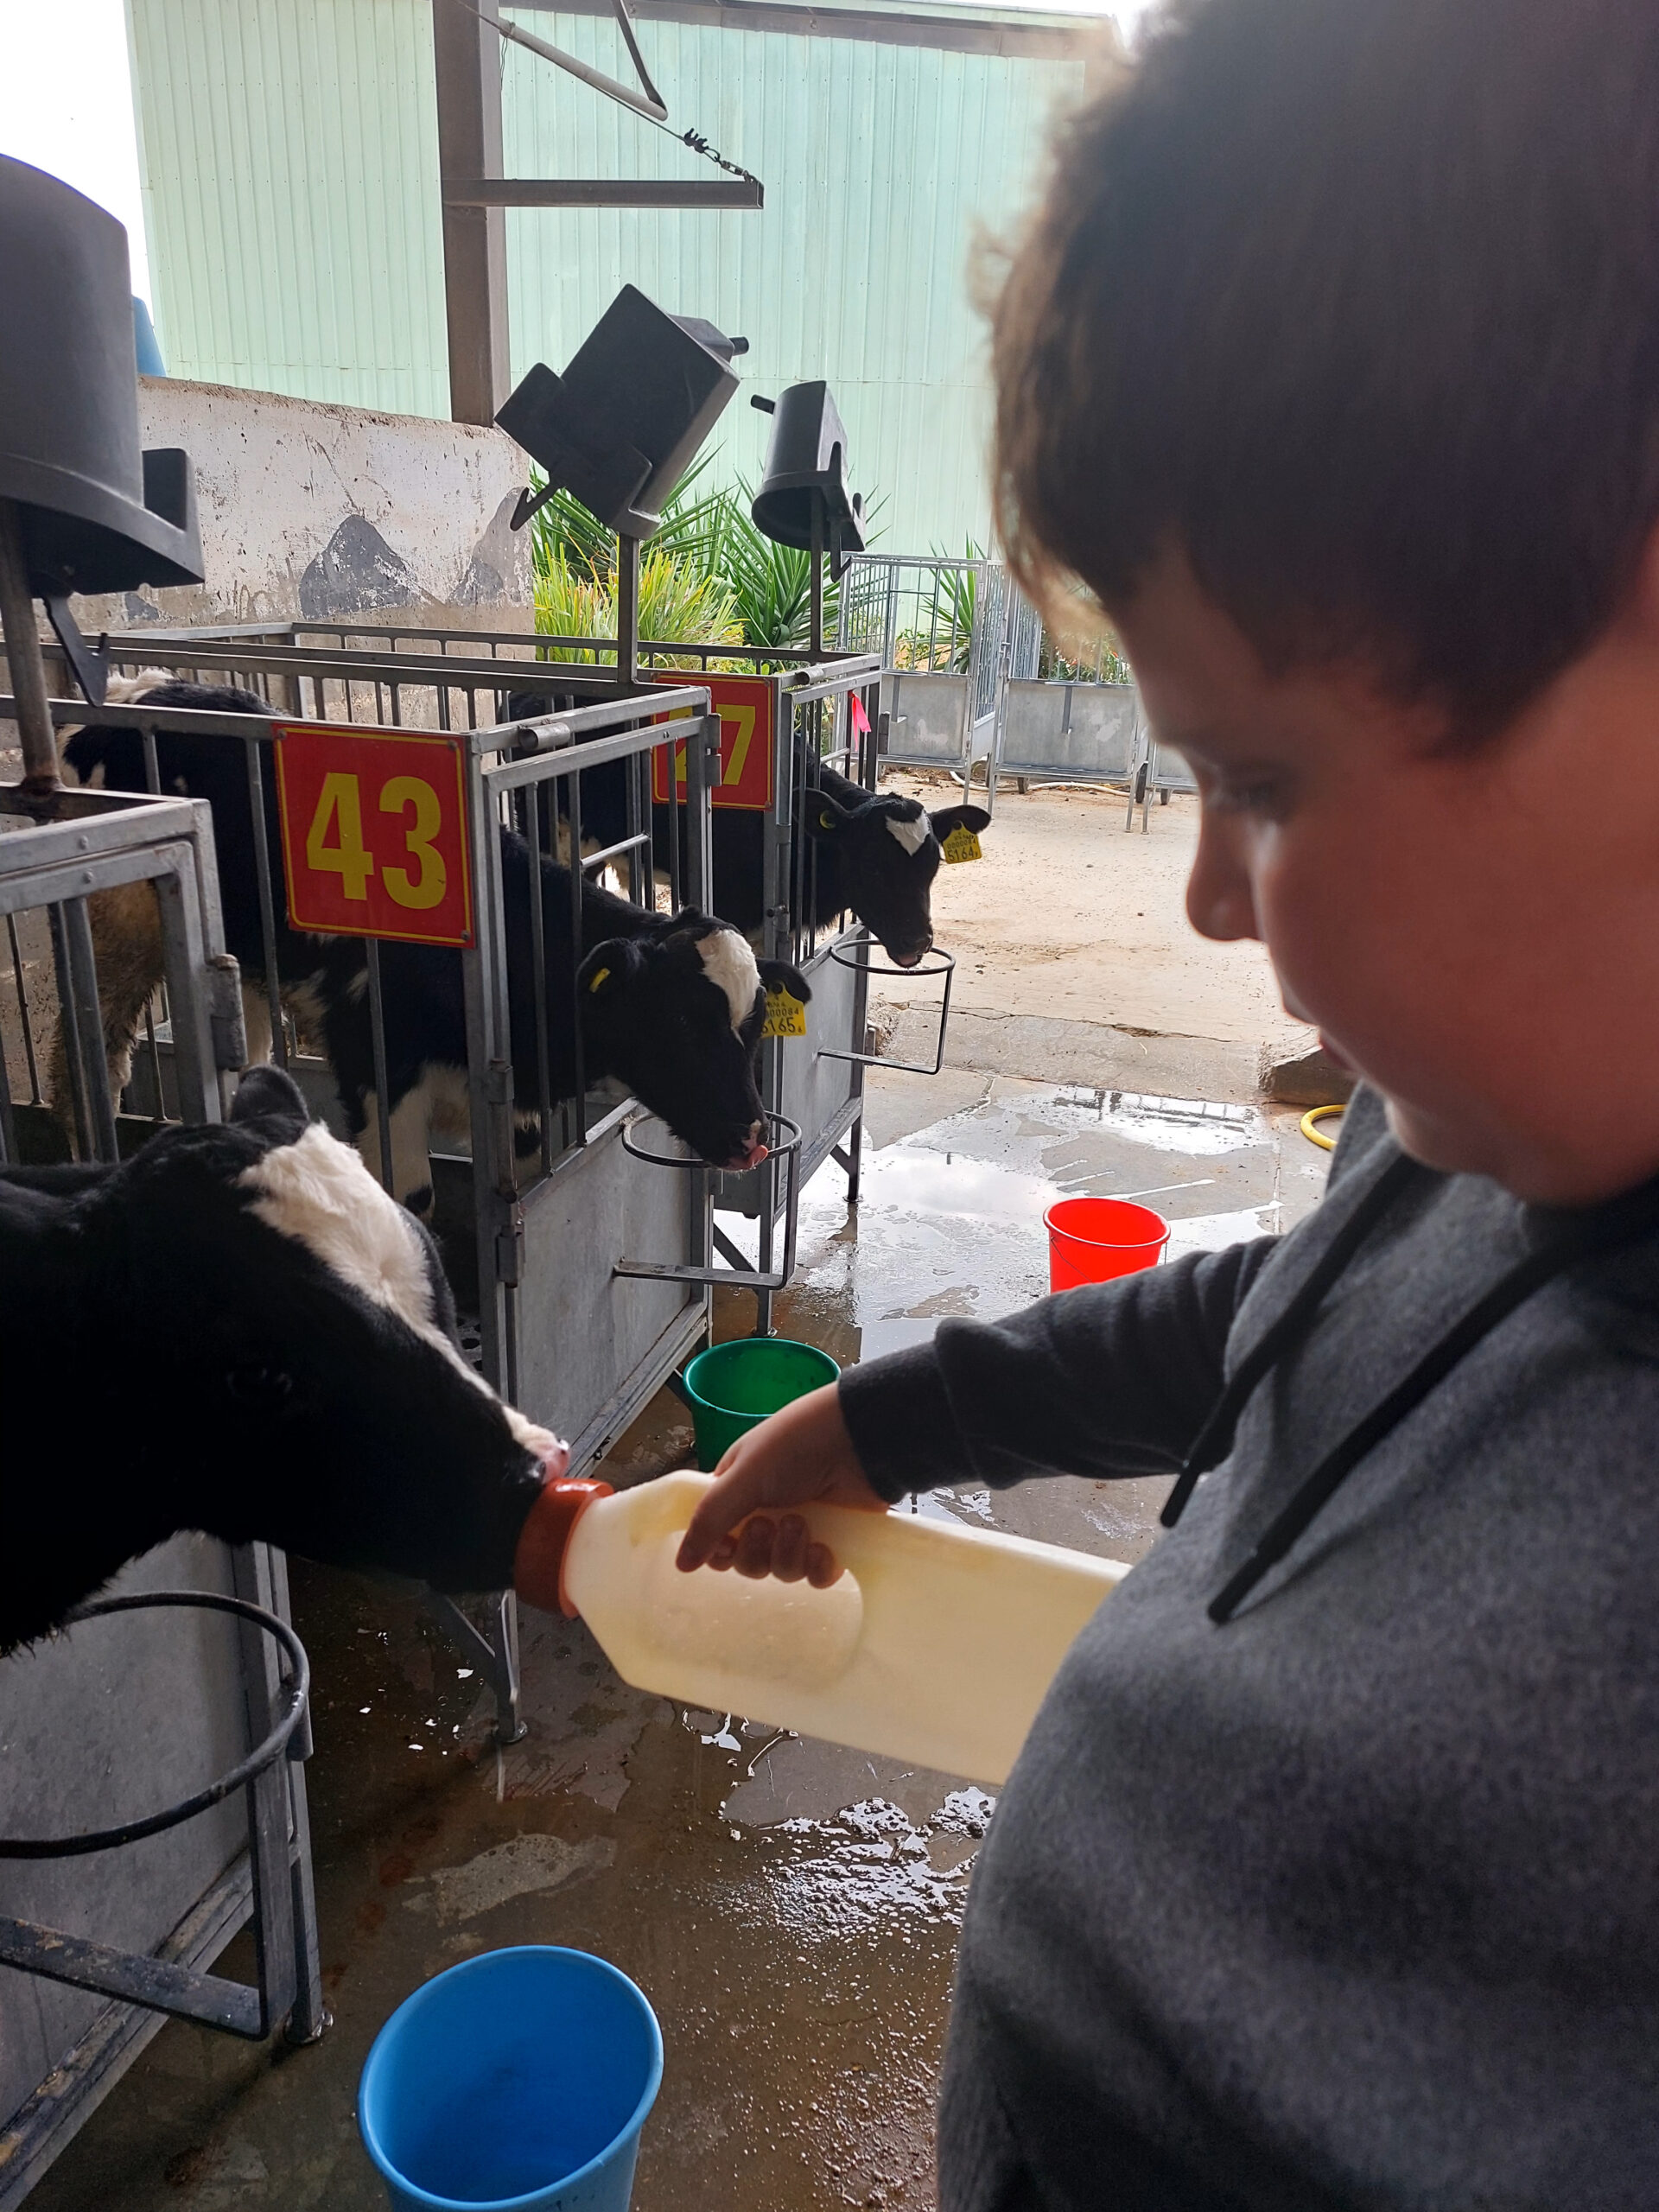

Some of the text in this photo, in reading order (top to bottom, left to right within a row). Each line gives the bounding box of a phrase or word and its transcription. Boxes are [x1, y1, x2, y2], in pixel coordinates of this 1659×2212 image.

[307, 772, 446, 909] 43
[947, 846, 974, 861] 5164
[766, 1007, 798, 1017] 00084
